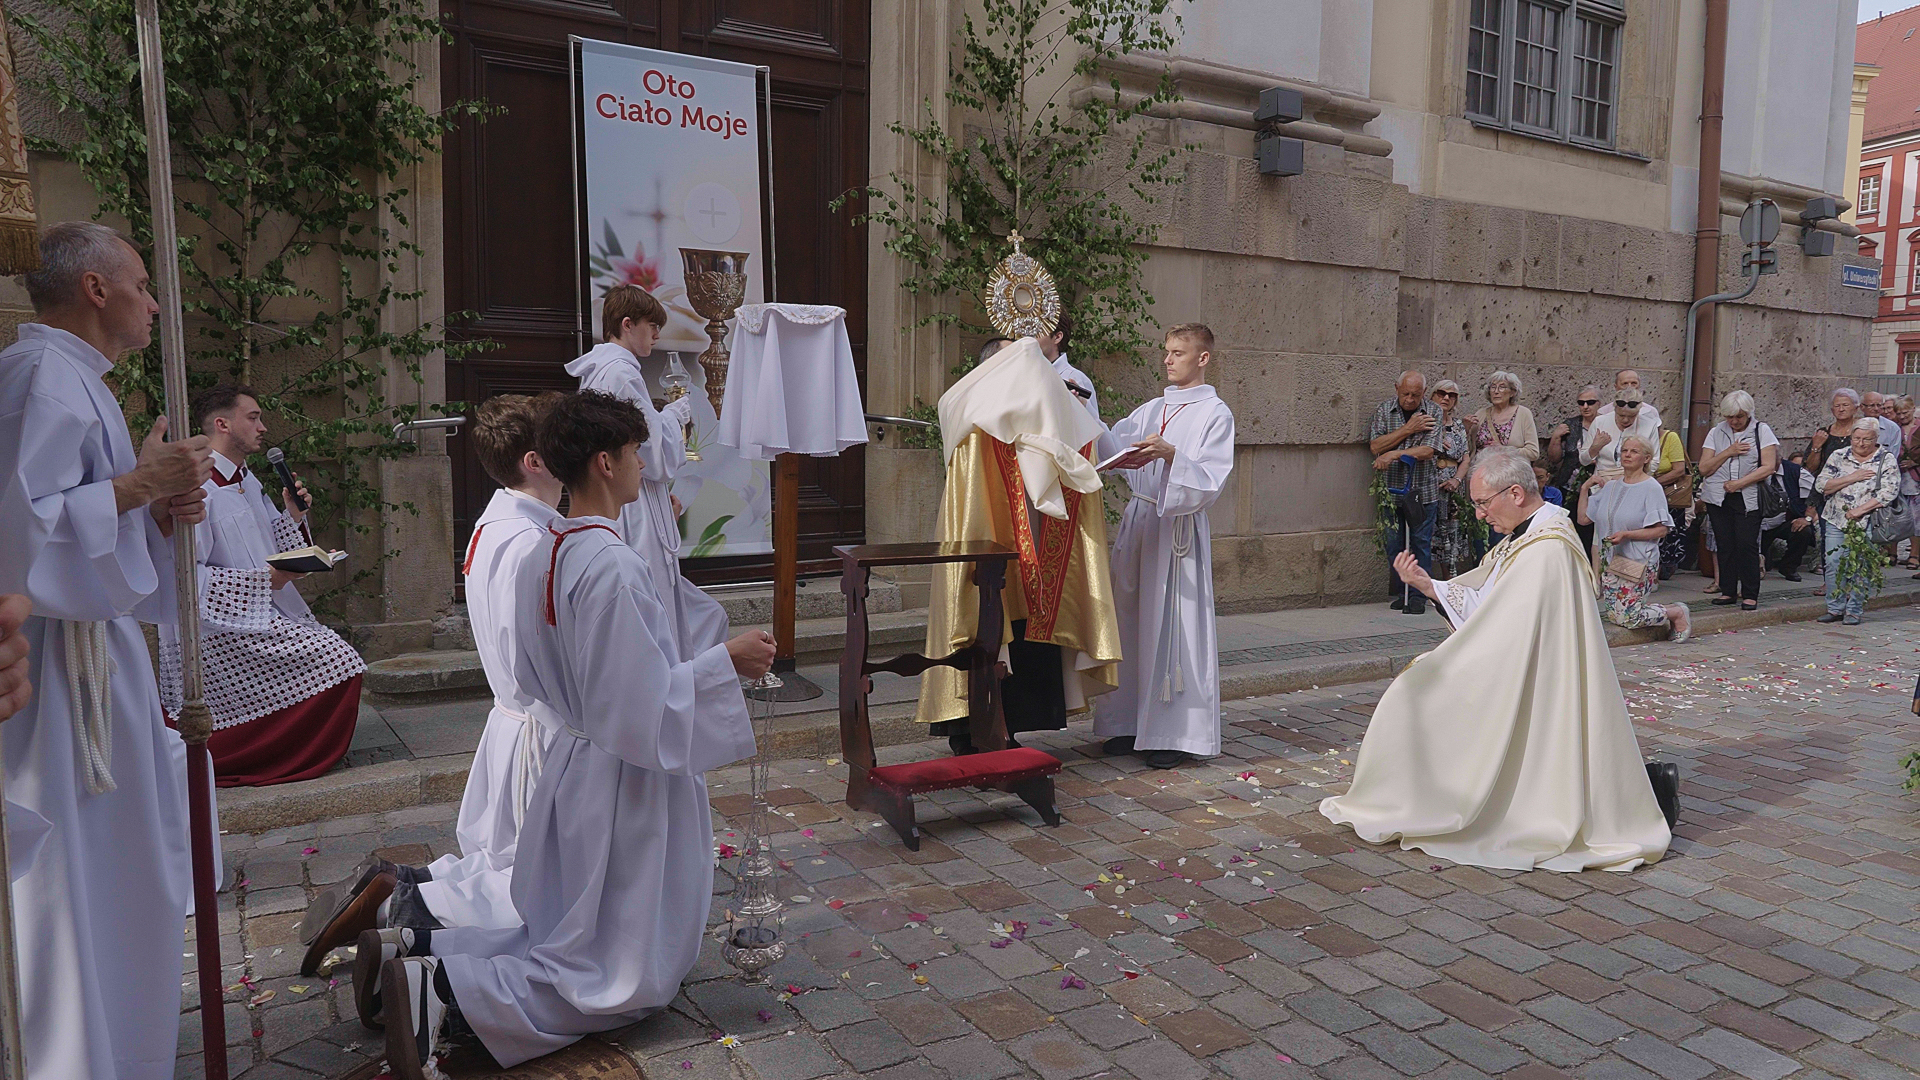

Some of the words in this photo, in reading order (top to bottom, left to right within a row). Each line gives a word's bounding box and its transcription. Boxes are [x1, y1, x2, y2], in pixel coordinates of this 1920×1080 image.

[643, 69, 695, 99] Oto
[596, 93, 672, 126] Ciało
[680, 105, 748, 140] Moje
